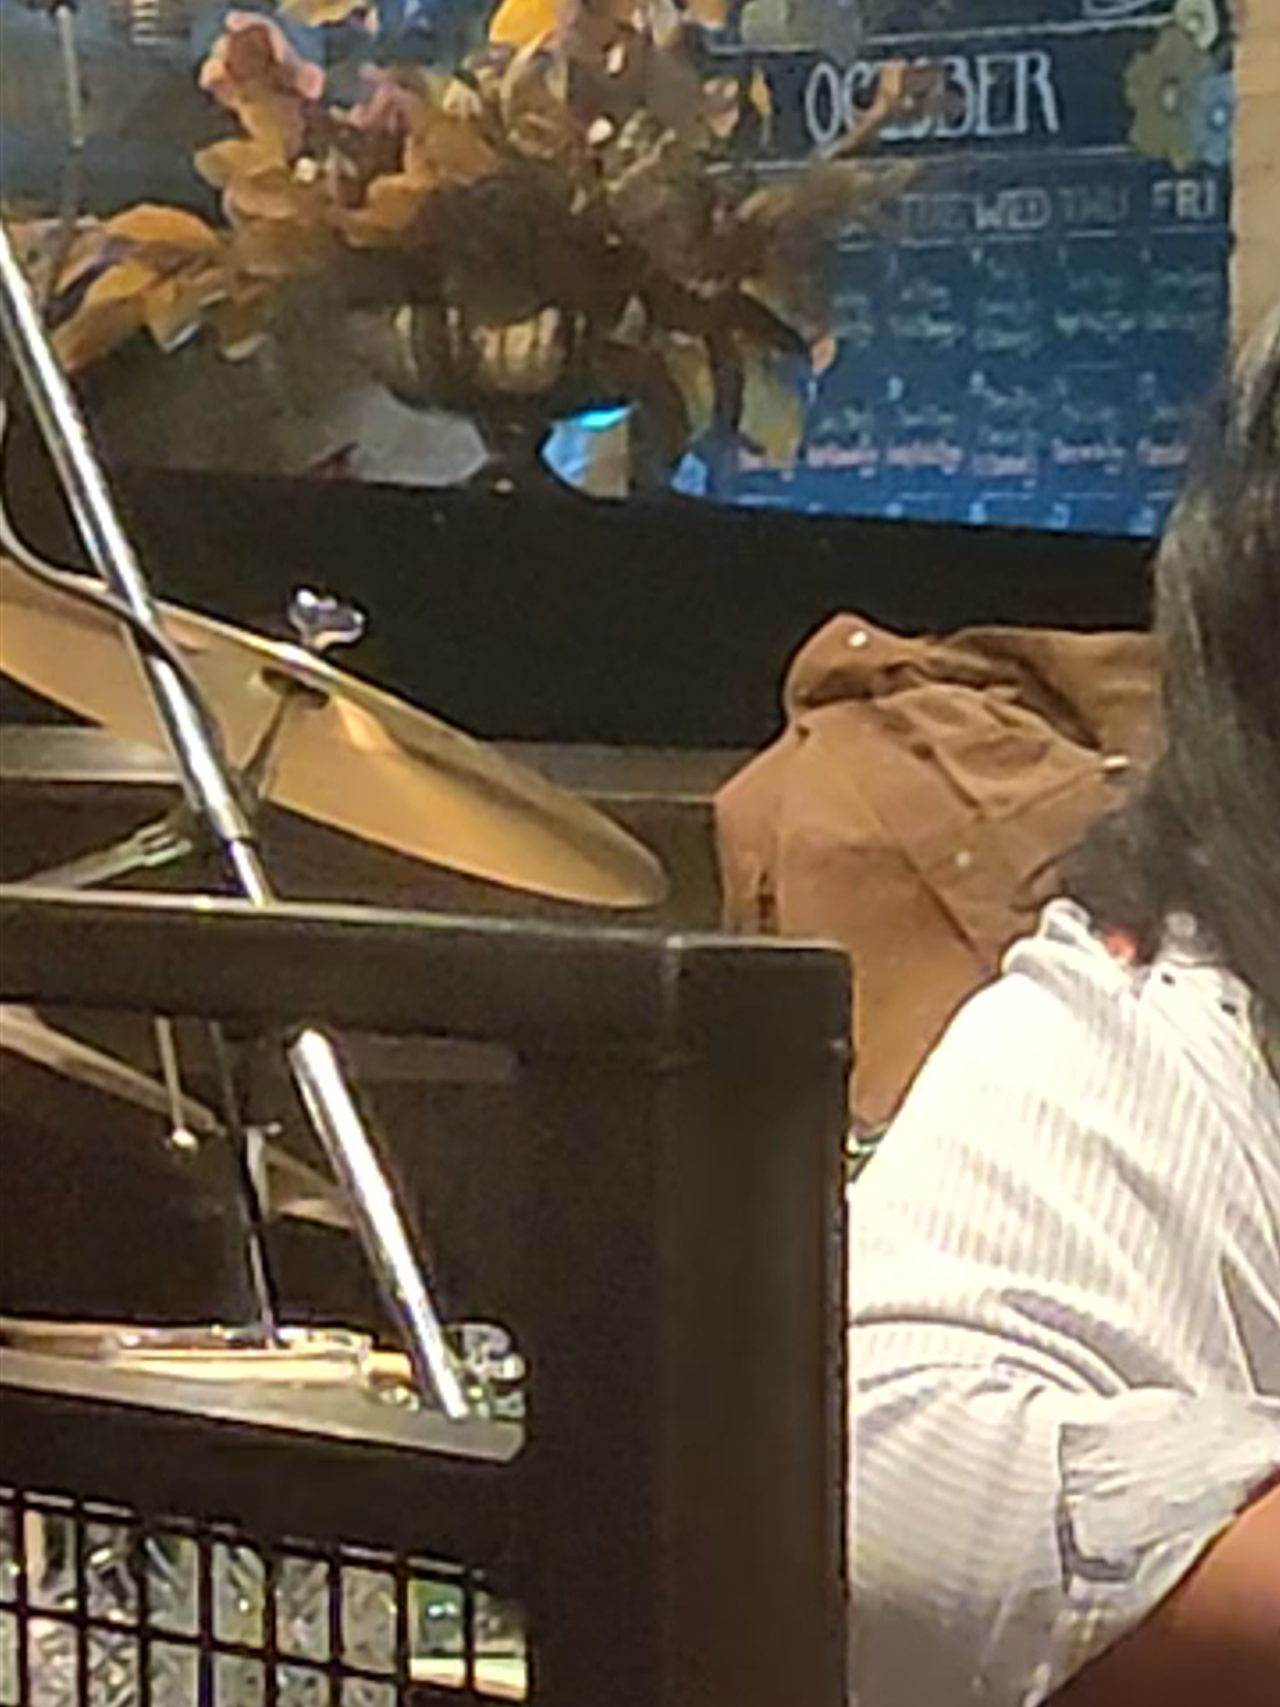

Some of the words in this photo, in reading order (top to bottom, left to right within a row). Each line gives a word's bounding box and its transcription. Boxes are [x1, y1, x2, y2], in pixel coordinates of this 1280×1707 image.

[805, 50, 1060, 143] OCBER
[974, 187, 1051, 231] WED
[1150, 178, 1217, 220] FRI
